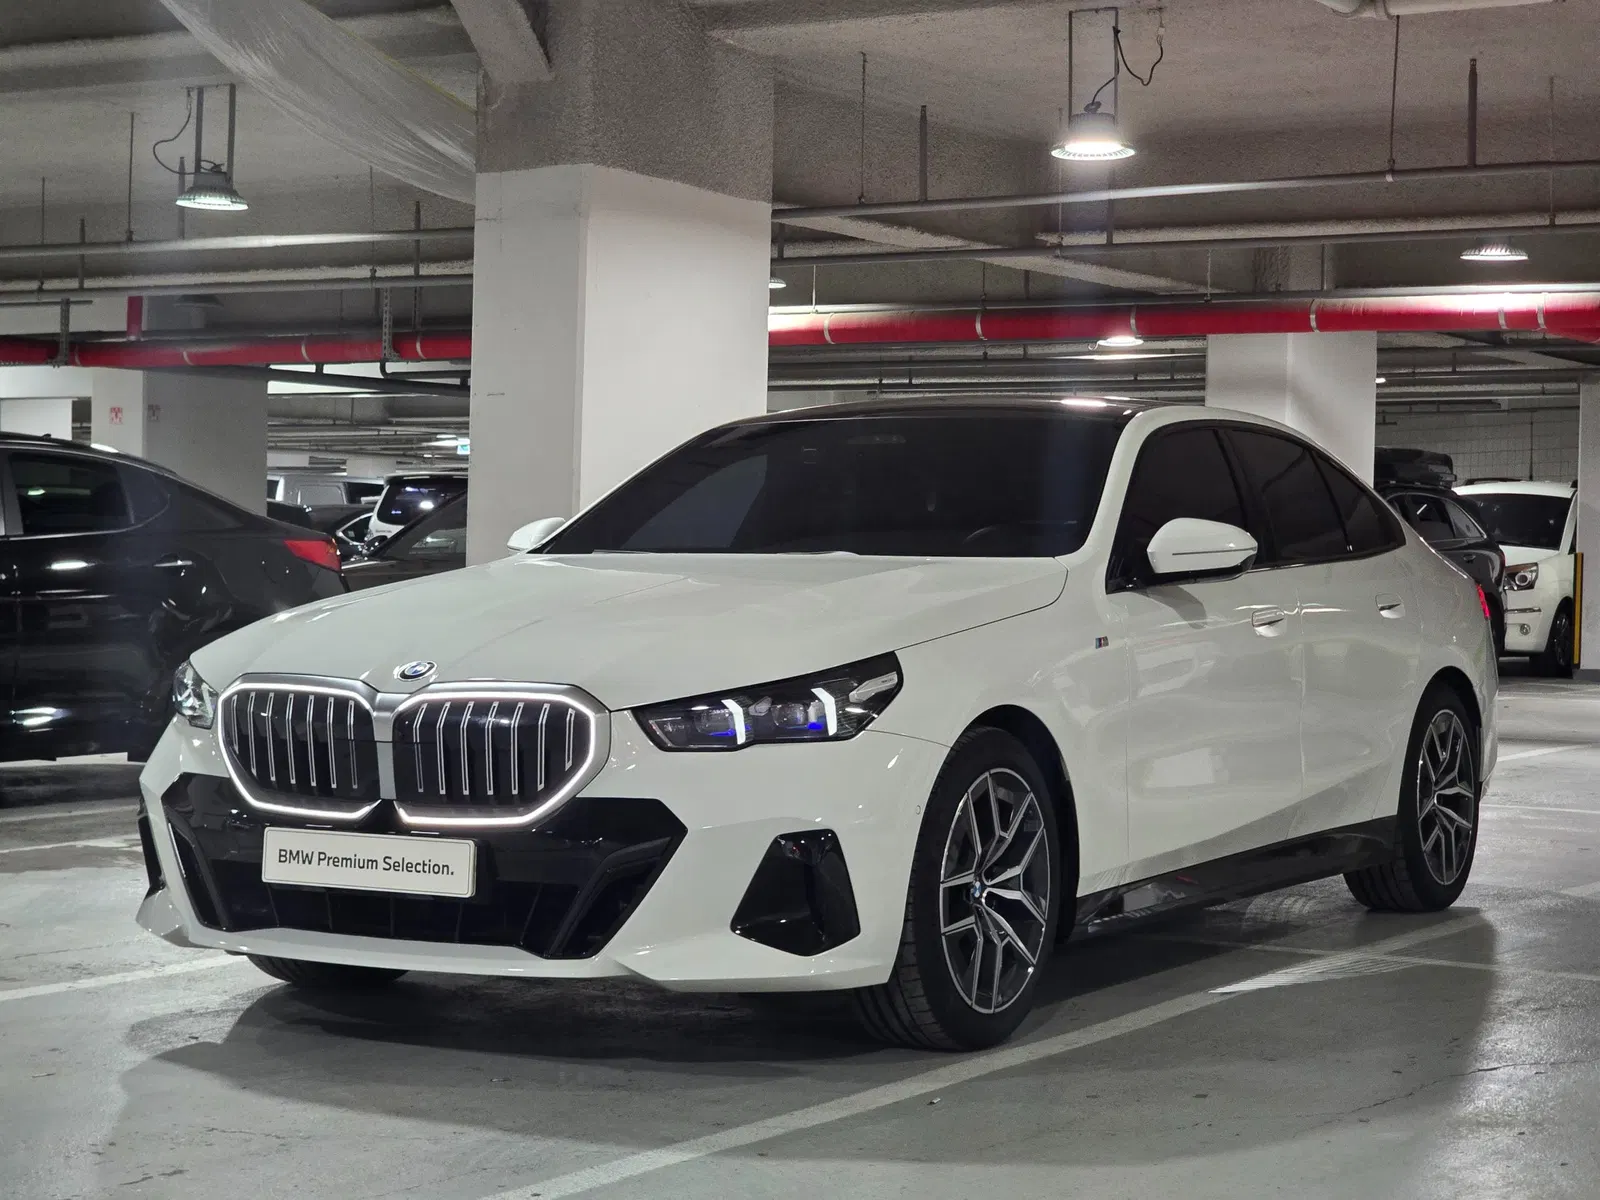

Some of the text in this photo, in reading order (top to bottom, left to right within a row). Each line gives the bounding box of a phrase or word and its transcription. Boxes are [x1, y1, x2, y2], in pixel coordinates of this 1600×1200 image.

[278, 848, 456, 876] BMW Premium Selection.
